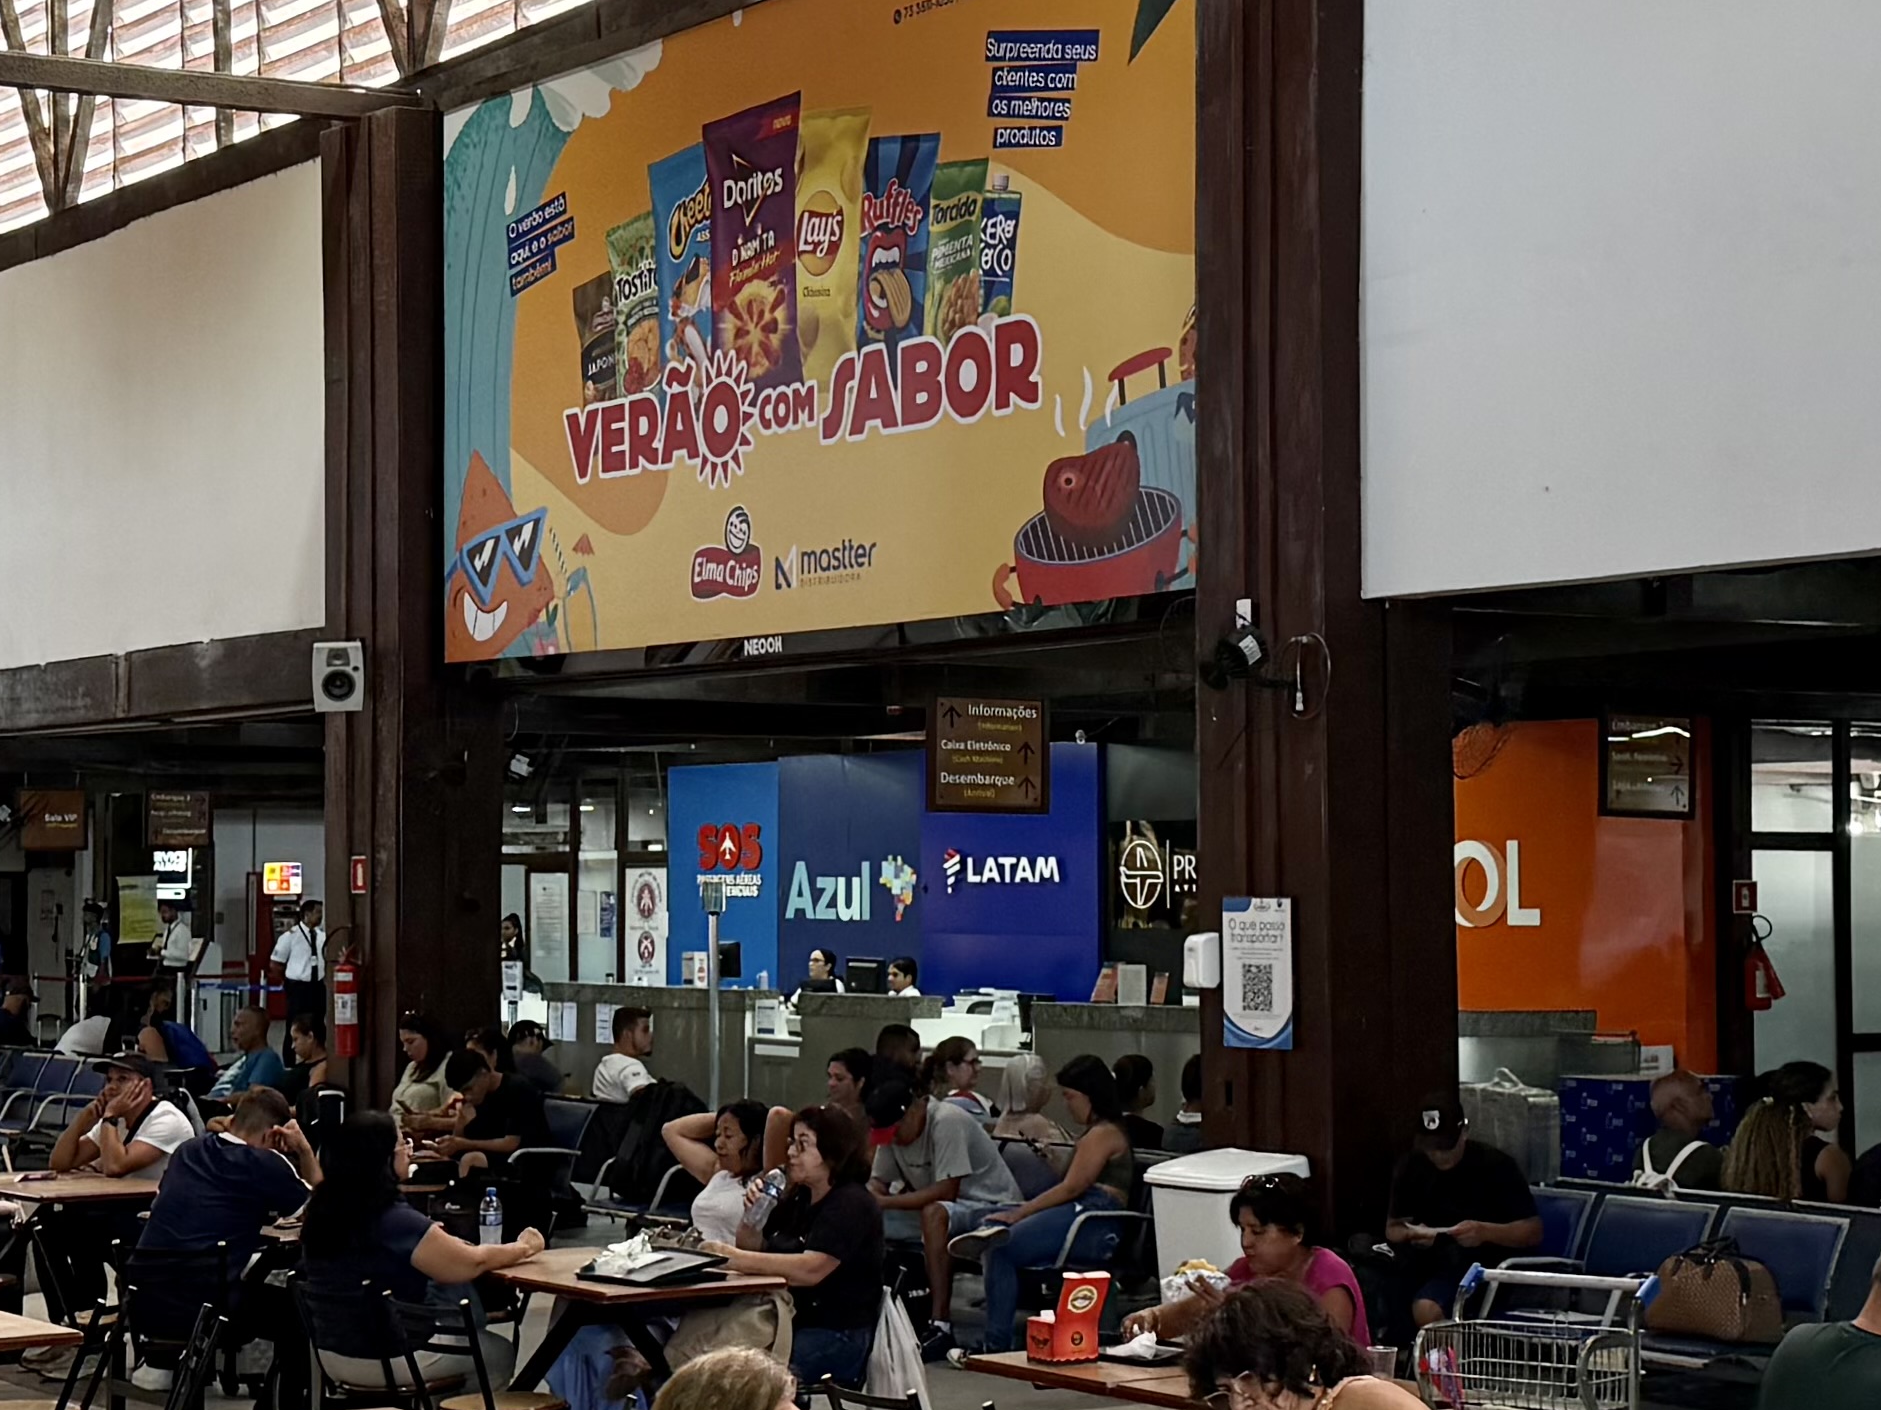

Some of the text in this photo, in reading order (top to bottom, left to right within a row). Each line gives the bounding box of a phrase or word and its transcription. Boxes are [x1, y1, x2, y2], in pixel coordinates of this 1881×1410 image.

[986, 38, 1097, 60] Surpreenda seus
[994, 67, 1077, 88] clientes com
[992, 97, 1071, 118] os melhores
[996, 127, 1057, 146] produtos
[723, 167, 783, 209] Doritos
[509, 223, 517, 238] O
[544, 196, 566, 220] está
[861, 178, 923, 236] Ruffles
[931, 195, 978, 227] Torcida
[547, 221, 573, 245] sabor
[798, 205, 843, 258] Lay's
[565, 315, 1042, 484] VERÃO COM SABOR
[801, 539, 877, 575] mastter
[694, 557, 759, 591] Elma Chips
[968, 704, 1037, 720] Informações
[941, 739, 1011, 751] Caixa Eletrônico
[941, 772, 1015, 787] Desembarque
[64, 813, 77, 822] VIP
[697, 822, 763, 871] SOS
[966, 856, 1060, 884] LATAM
[1173, 854, 1197, 881] PR
[785, 860, 871, 921] Azul
[1454, 839, 1541, 928] OL
[1229, 918, 1237, 930] O
[1239, 920, 1257, 932] que
